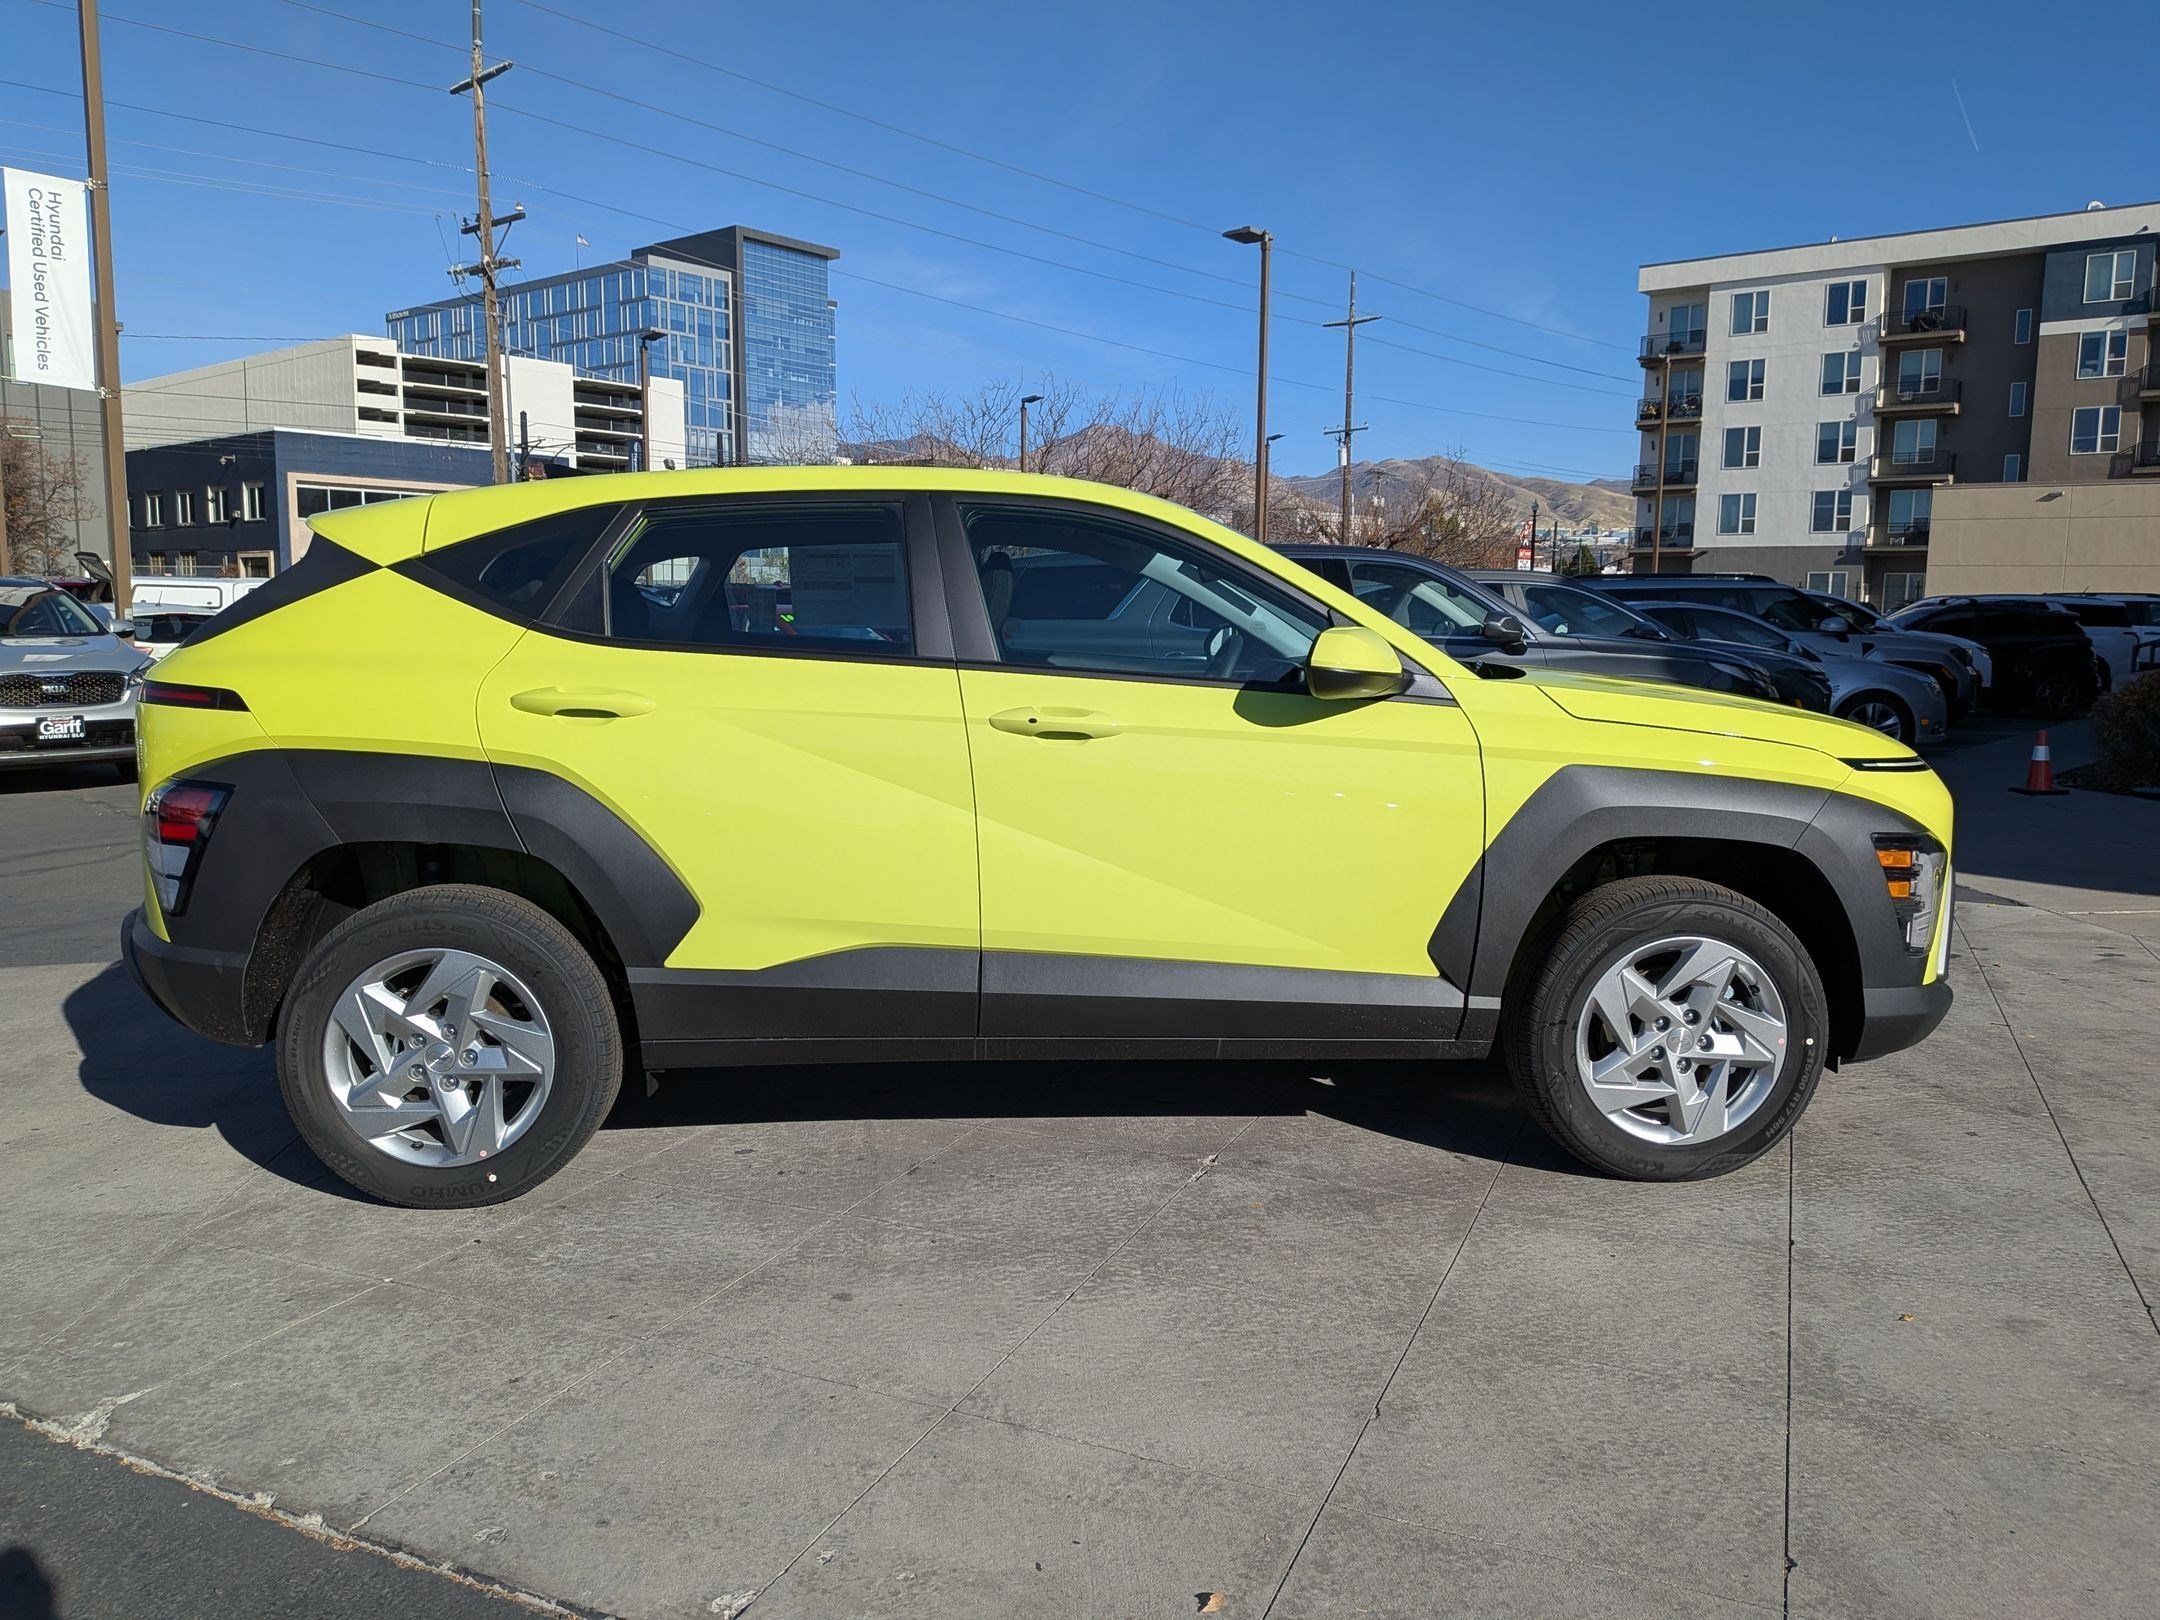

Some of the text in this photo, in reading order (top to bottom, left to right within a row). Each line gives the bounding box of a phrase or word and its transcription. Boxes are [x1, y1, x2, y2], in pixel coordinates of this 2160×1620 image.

[46, 191, 66, 261] Hyundai
[28, 187, 51, 371] Certified Used Vehicles
[48, 685, 66, 693] KIA
[40, 720, 82, 735] Garff
[1576, 941, 1609, 977] SEASON
[1798, 1048, 1816, 1090] 215/60
[1785, 1092, 1801, 1116] R17
